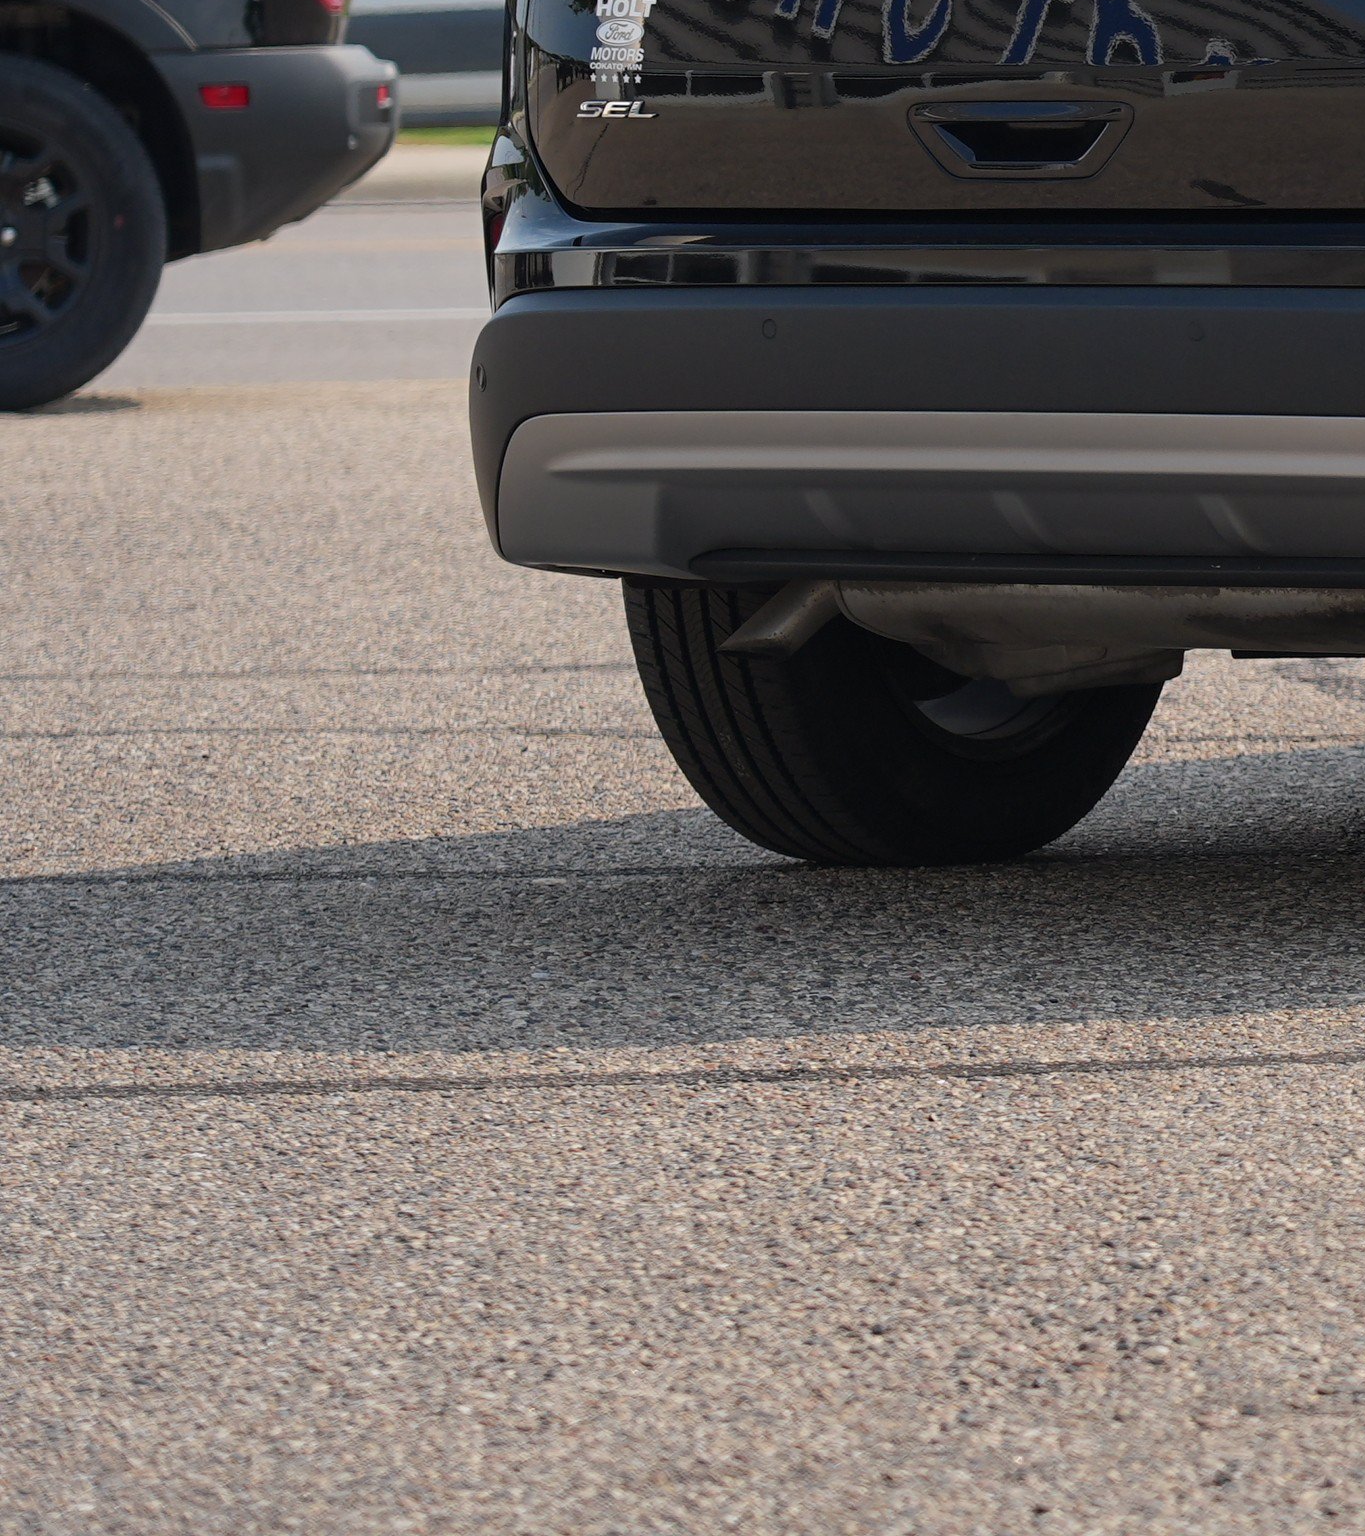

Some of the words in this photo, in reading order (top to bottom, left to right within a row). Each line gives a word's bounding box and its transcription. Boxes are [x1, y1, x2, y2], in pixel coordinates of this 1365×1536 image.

[604, 22, 635, 41] Ford
[590, 47, 645, 62] MOTORS
[628, 63, 643, 71] MN
[576, 100, 659, 119] SEL
